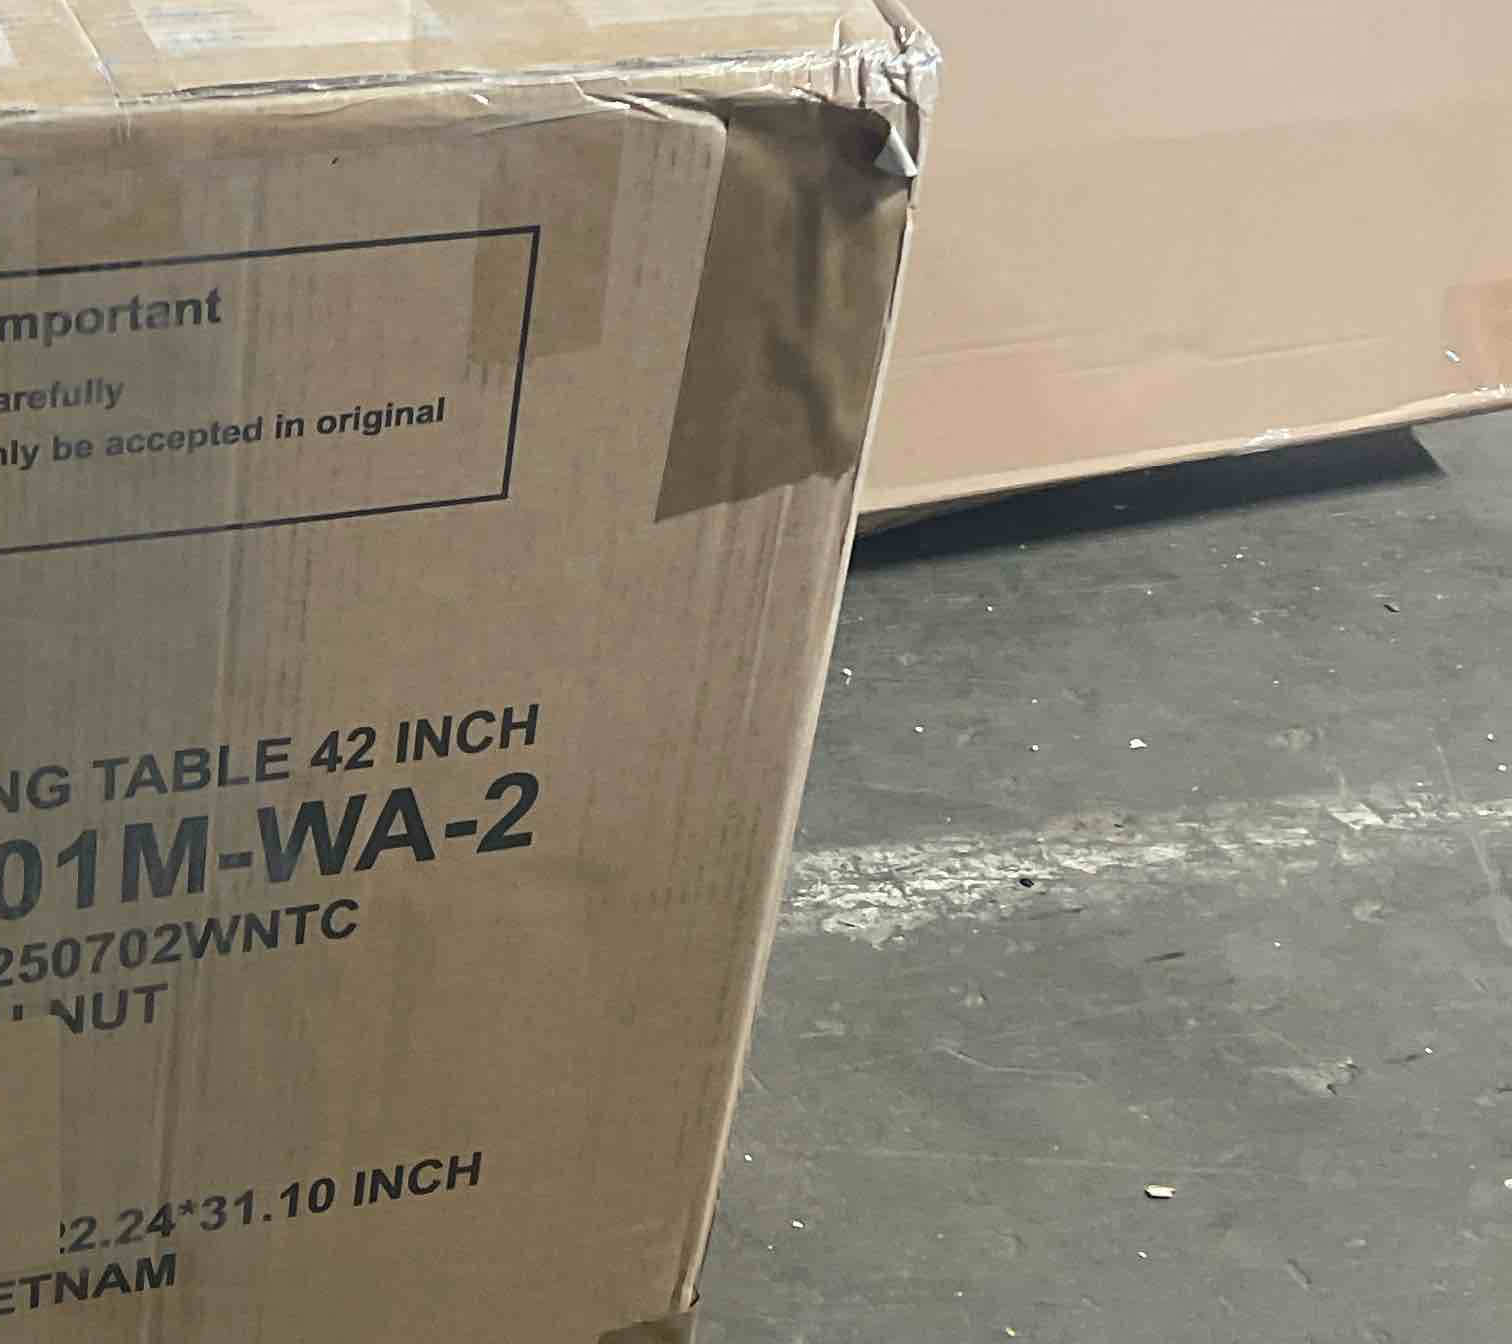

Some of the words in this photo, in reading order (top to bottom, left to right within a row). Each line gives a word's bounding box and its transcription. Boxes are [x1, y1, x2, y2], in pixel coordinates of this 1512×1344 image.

[52, 432, 94, 462] be
[104, 414, 263, 464] accepted
[275, 409, 305, 441] in
[316, 396, 447, 442] original
[93, 736, 292, 802] TABLE
[309, 726, 377, 774] 42
[395, 703, 541, 763] INCH
[59, 1176, 336, 1255] 2.2431.10
[352, 1151, 483, 1208] INCH
